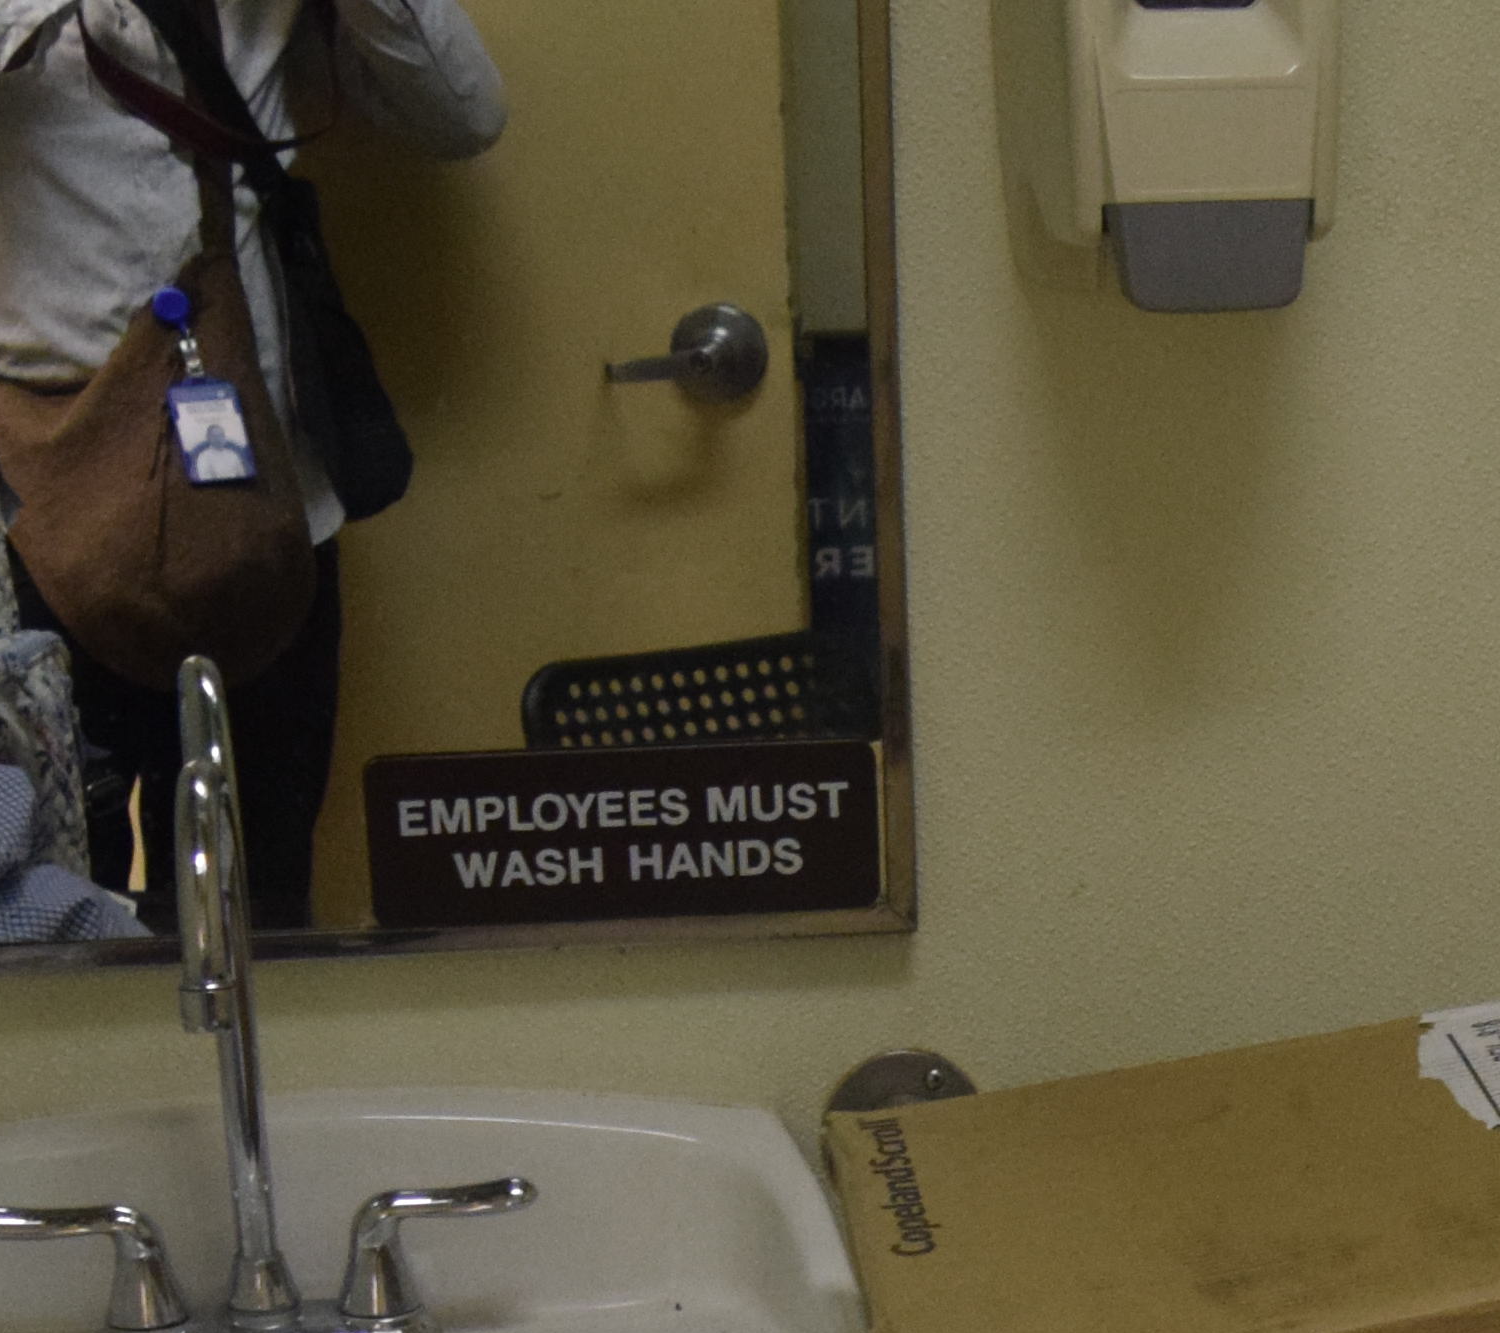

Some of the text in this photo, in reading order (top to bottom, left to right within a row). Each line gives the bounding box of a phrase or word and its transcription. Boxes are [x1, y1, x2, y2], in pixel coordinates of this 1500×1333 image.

[397, 780, 850, 838] EMPLOYEES MUST
[452, 837, 805, 890] WASH HANDS
